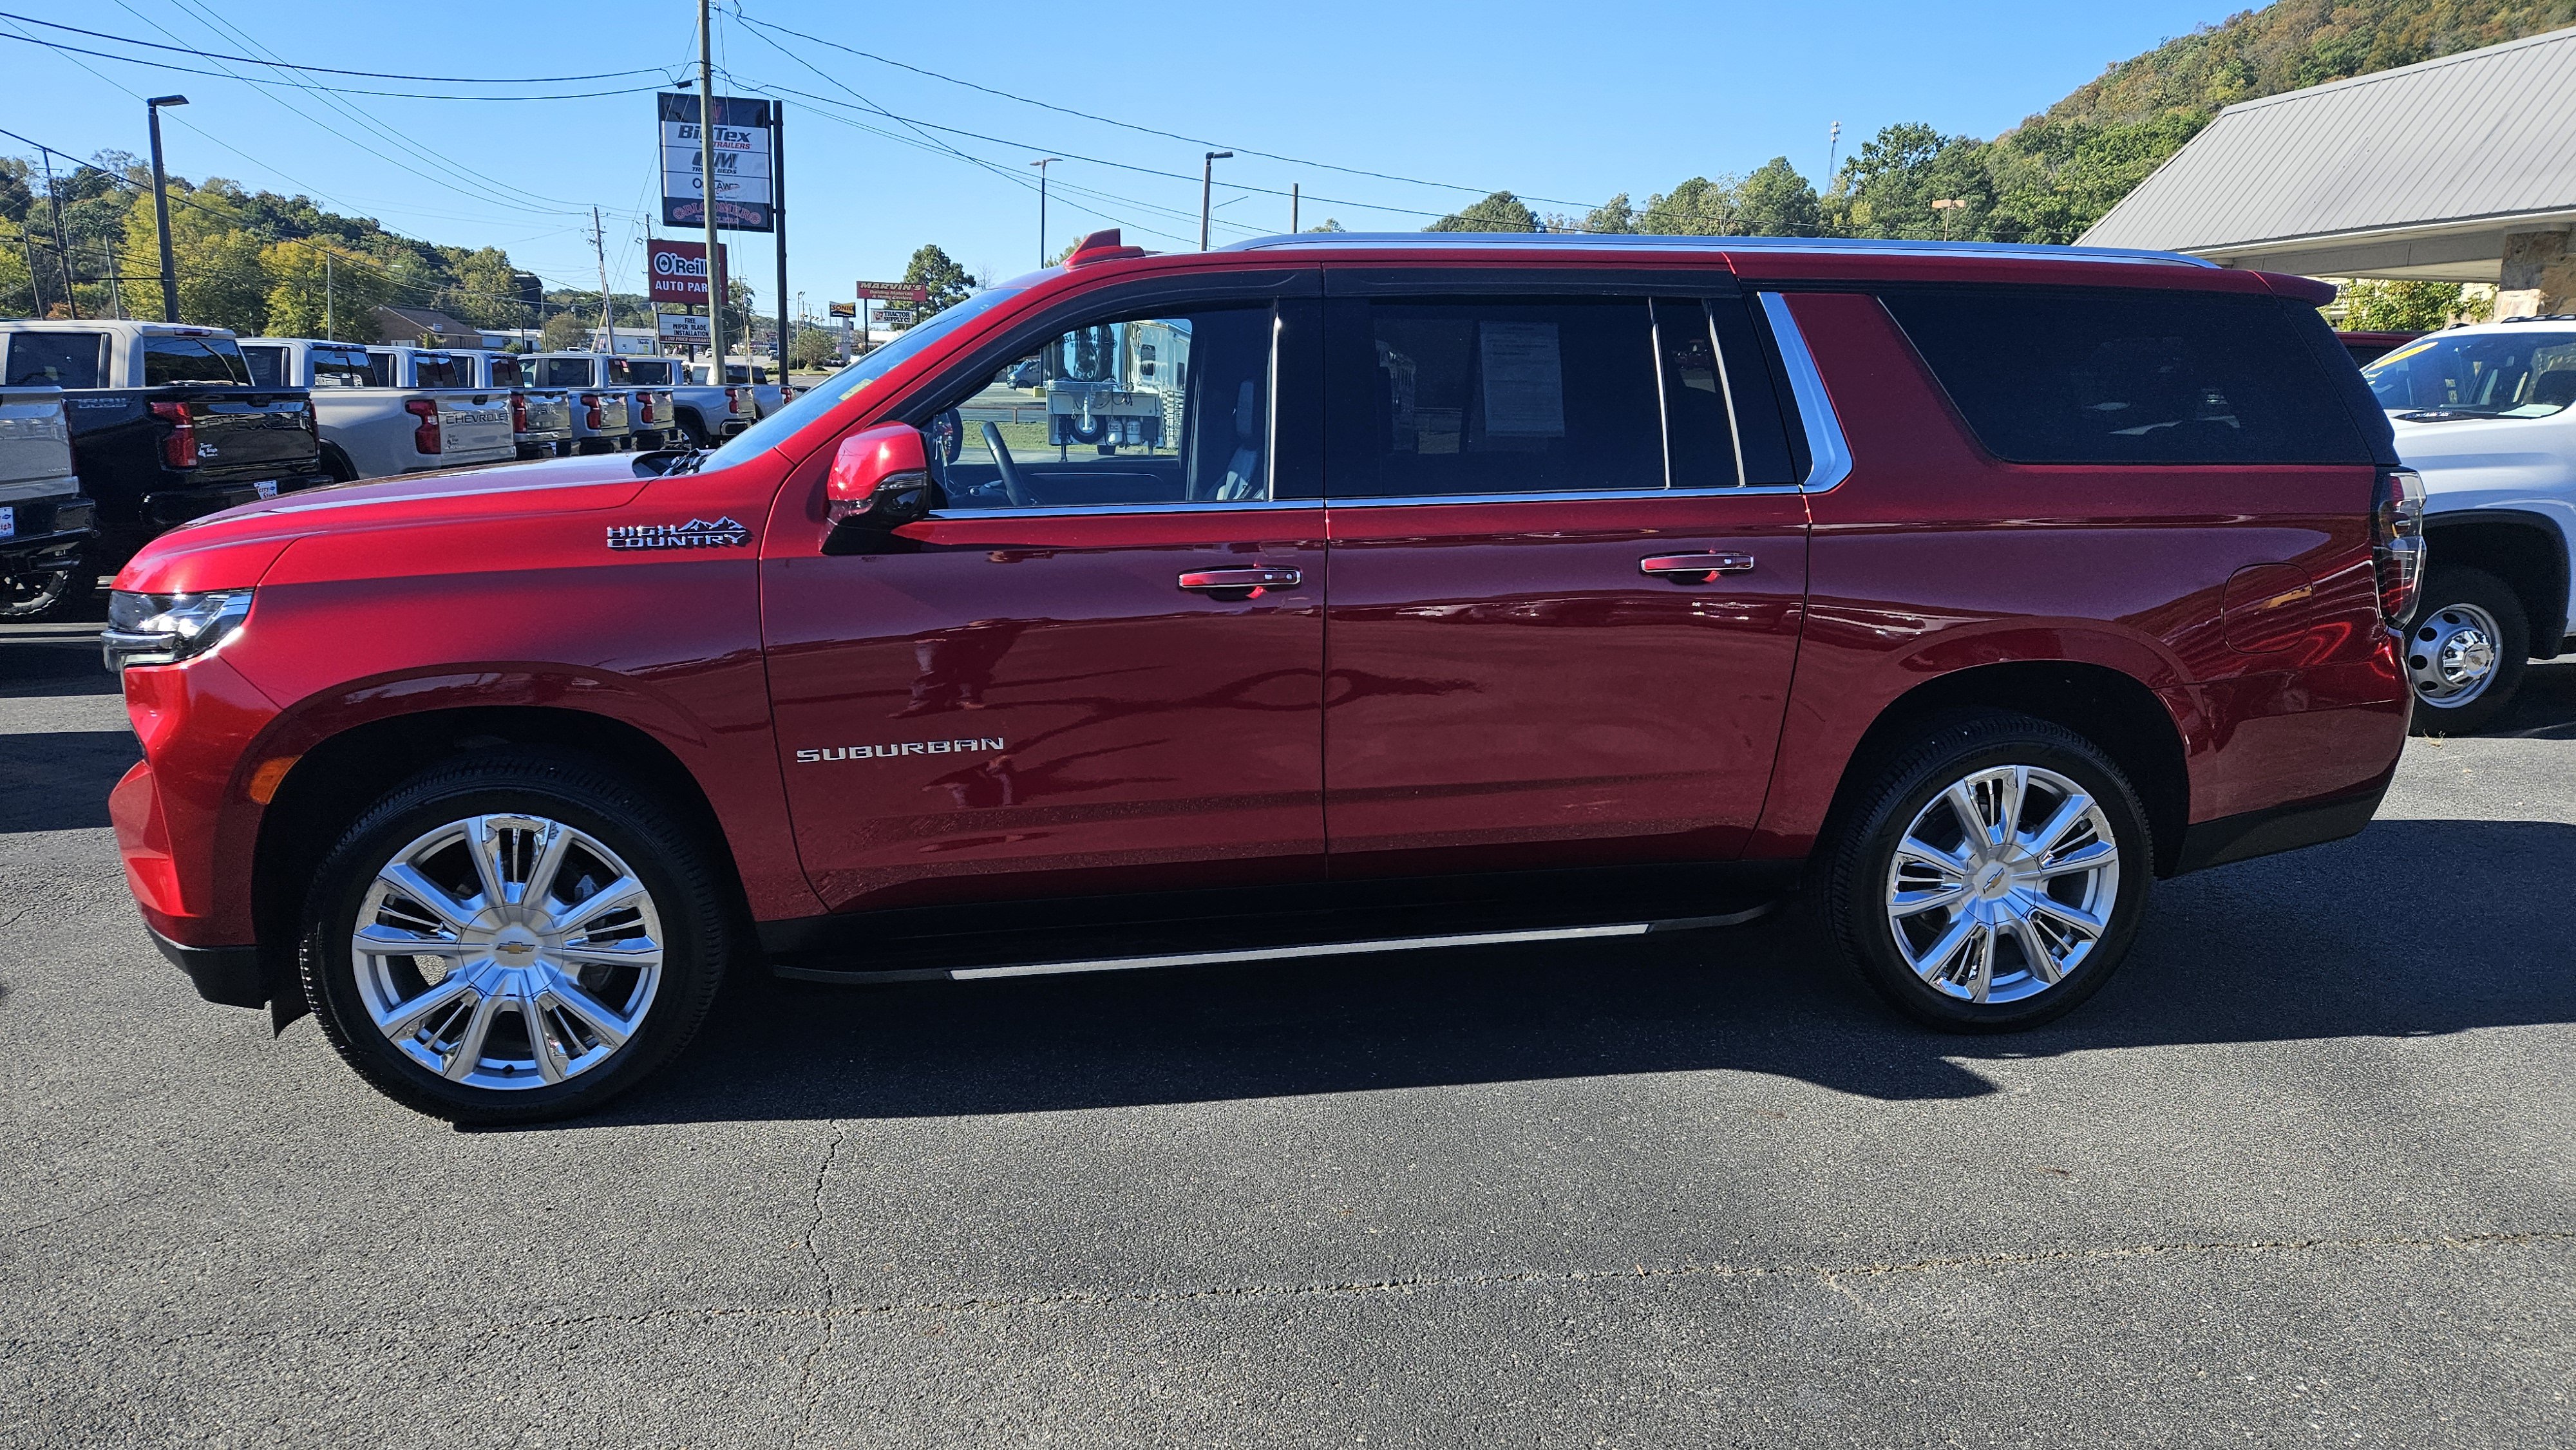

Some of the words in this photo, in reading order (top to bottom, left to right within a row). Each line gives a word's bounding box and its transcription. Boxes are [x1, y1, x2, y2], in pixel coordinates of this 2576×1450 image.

[713, 141, 751, 149] TRAILERS
[654, 252, 721, 277] O'Reill
[656, 280, 683, 292] AUTO
[687, 282, 722, 293] PAR
[860, 283, 922, 291] MARVIN'S
[446, 413, 509, 424] CHEVROLET
[607, 525, 676, 537] HIGH
[607, 534, 746, 548] COUNTRY
[797, 737, 1004, 763] SUBURBAN
